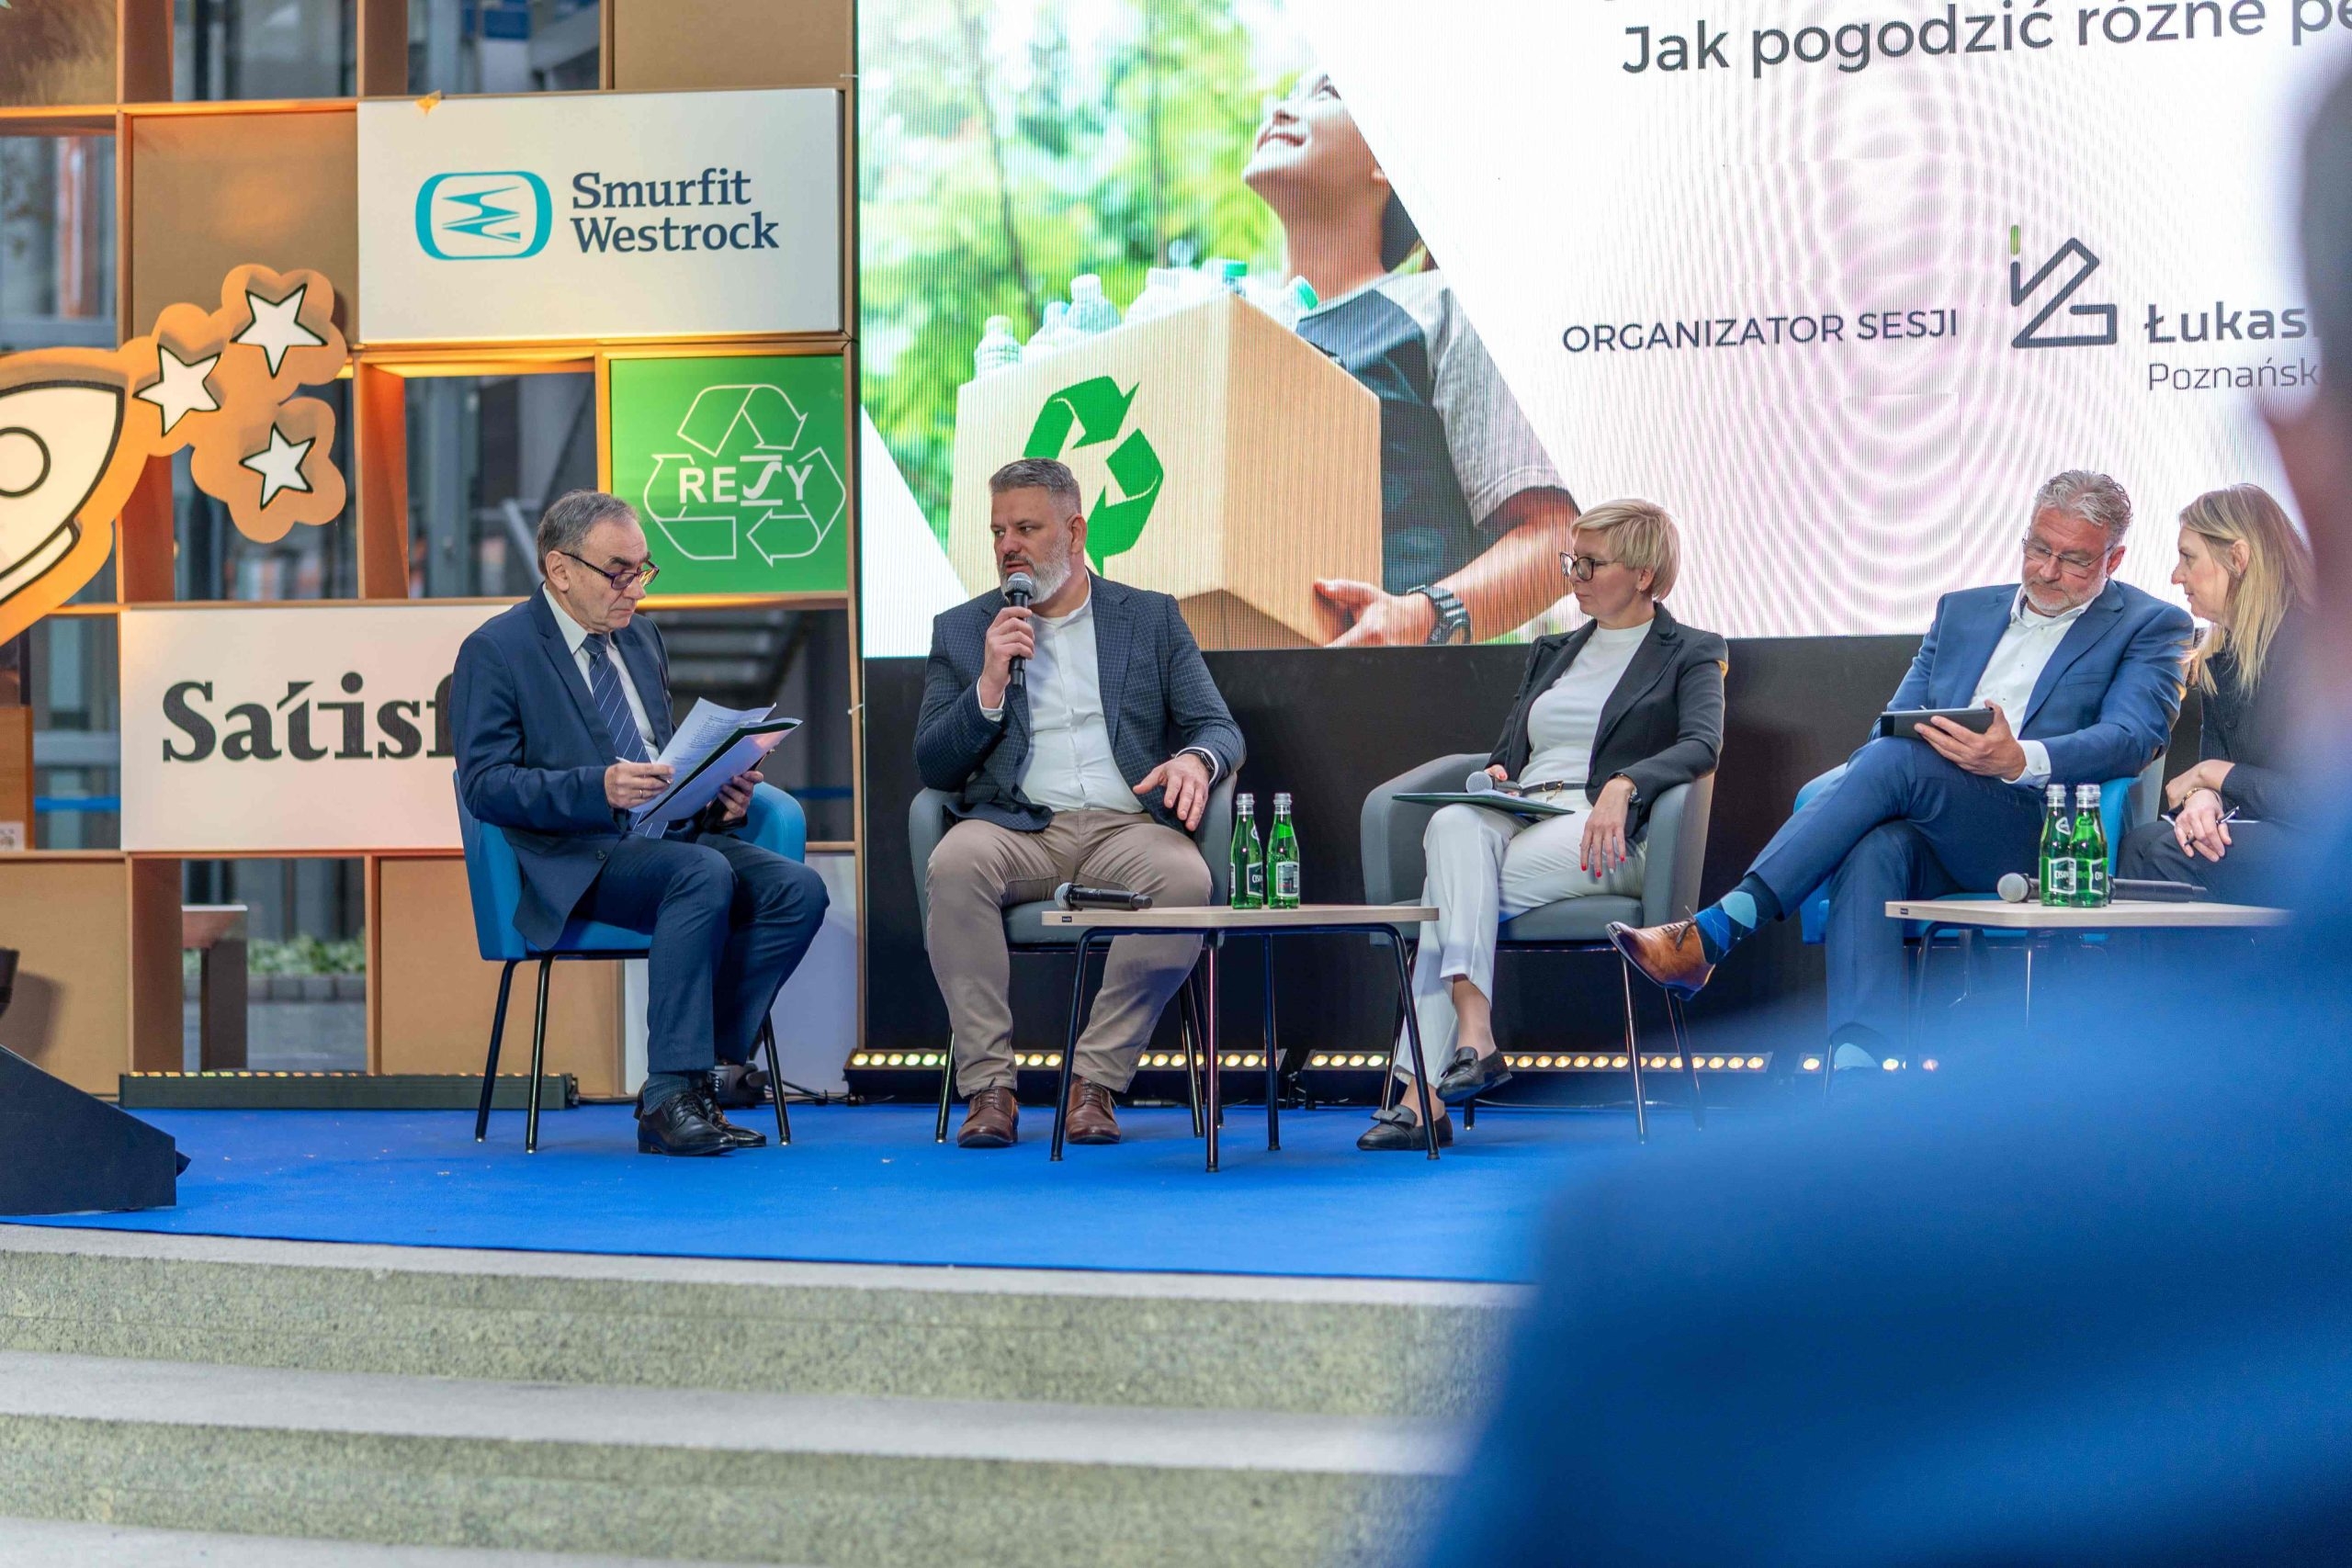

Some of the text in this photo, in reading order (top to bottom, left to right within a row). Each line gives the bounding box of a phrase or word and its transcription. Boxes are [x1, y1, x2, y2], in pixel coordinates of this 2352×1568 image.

[1623, 20, 1730, 73] Jak
[1753, 0, 2053, 78] pogodzić
[572, 167, 752, 209] Smurfit
[570, 211, 779, 254] Westrock
[1563, 309, 1957, 352] ORGANIZATOR SESJI
